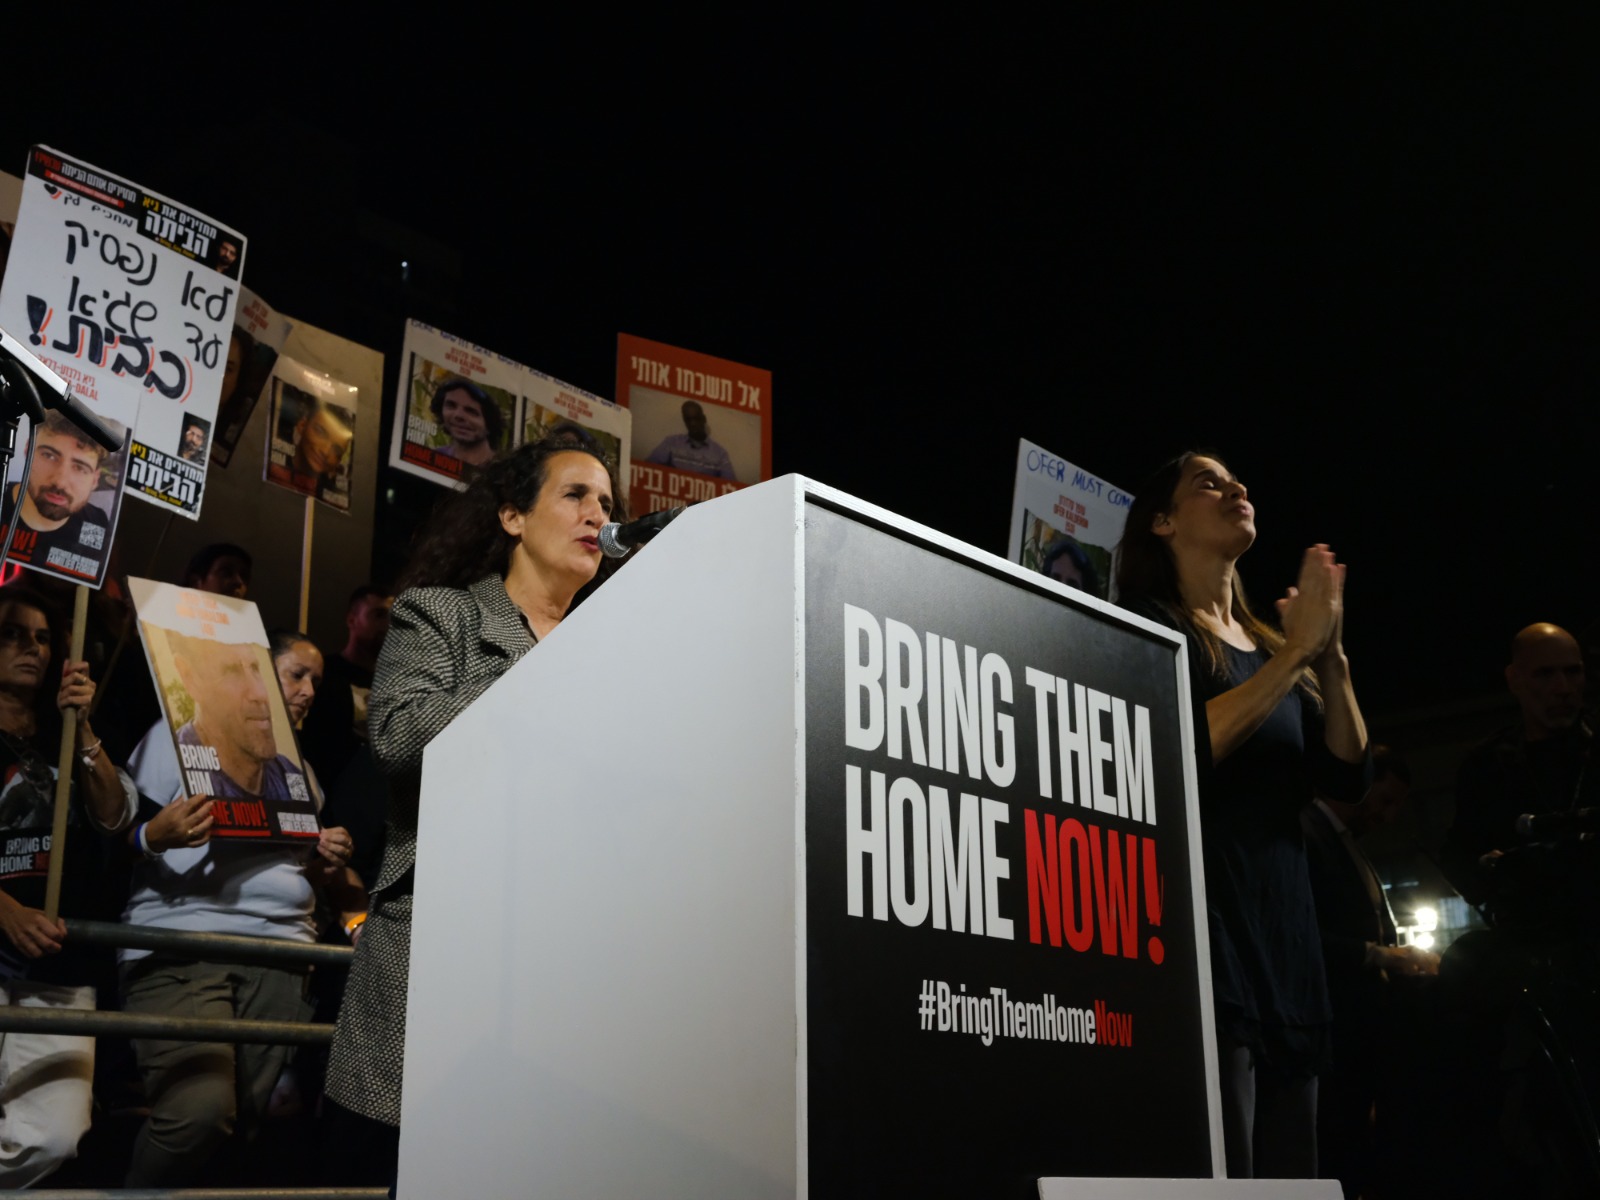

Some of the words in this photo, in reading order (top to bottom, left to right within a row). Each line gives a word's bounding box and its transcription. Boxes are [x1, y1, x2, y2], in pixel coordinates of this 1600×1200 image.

[142, 195, 160, 213] גיא
[161, 203, 178, 218] את
[144, 210, 211, 259] הביתה
[179, 212, 218, 240] מחזירים
[64, 219, 158, 286] נפסיק
[181, 270, 234, 321] לא
[183, 321, 223, 370] עד
[631, 355, 671, 388] אותי
[675, 366, 733, 404] תשכחו
[737, 379, 761, 411] אל
[406, 426, 426, 446] HIM
[407, 414, 438, 437] BRING
[148, 452, 164, 467] את
[164, 459, 205, 483] מחזירים
[1026, 449, 1066, 483] OFER
[1071, 470, 1104, 498] MUST
[130, 457, 196, 504] הביתה
[844, 602, 1017, 788] BRING
[1025, 666, 1157, 826] THEM
[178, 743, 221, 772] BRING
[185, 770, 215, 797] HIM
[230, 800, 269, 828] NOW!
[5, 836, 40, 856] BRING
[0, 853, 34, 875] HOME
[845, 764, 1015, 941] HOME
[1024, 808, 1165, 965] NOW!
[918, 979, 1133, 1047] #BringThemHomeNow
